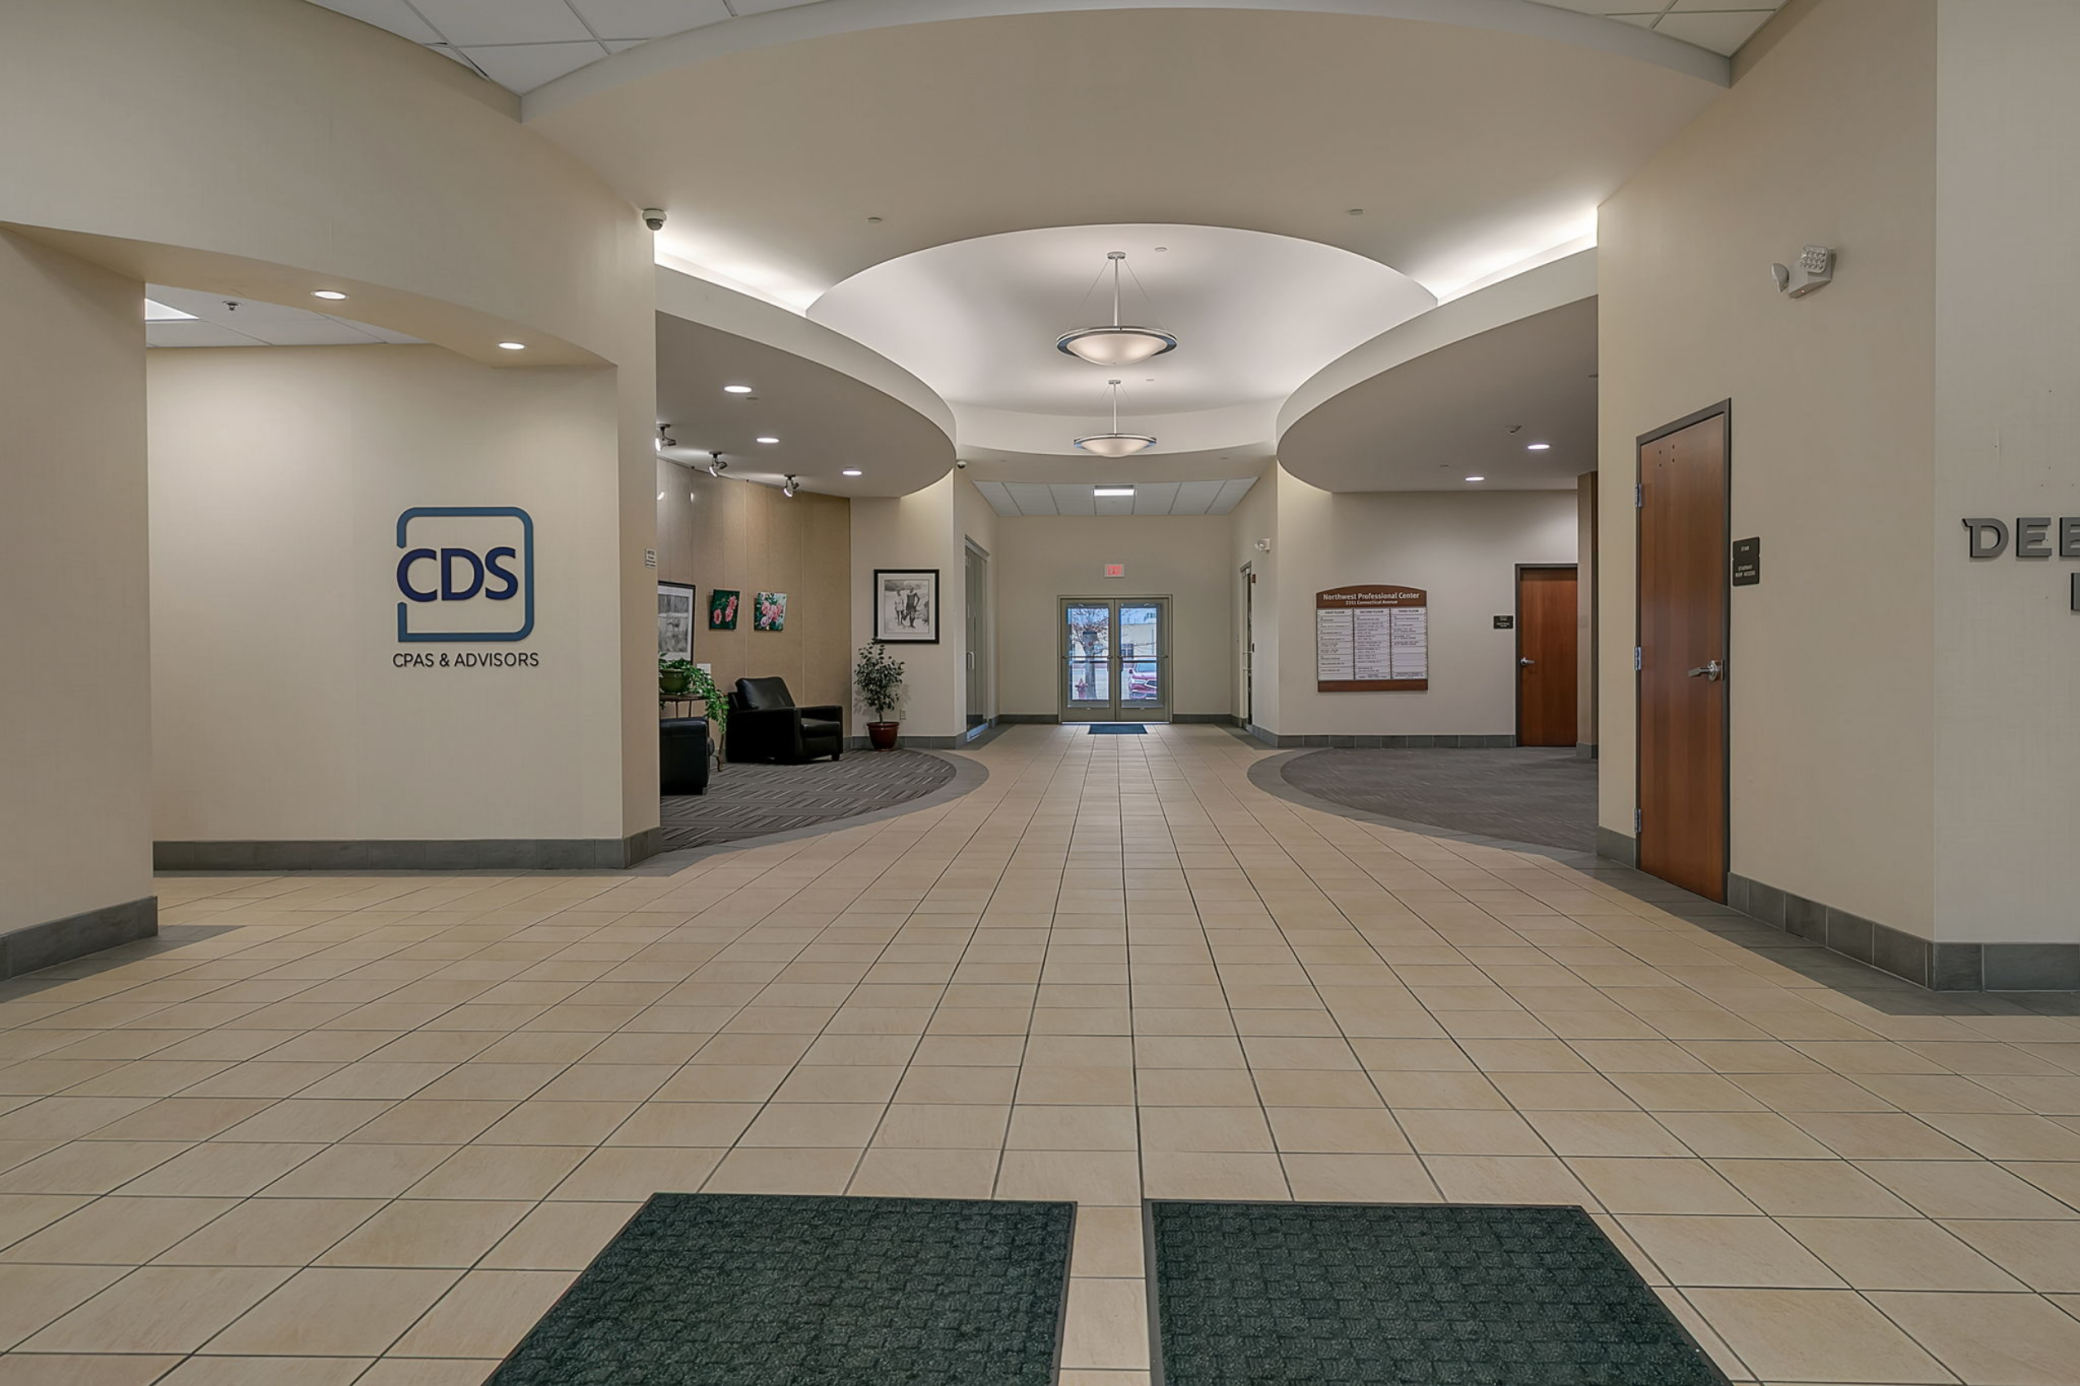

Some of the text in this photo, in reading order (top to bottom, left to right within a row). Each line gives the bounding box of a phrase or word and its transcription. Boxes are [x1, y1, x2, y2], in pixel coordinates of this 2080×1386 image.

[396, 546, 519, 603] CDS
[1358, 592, 1397, 600] Professional
[1398, 591, 1420, 599] Center
[392, 652, 540, 668] CPAS & ADVISORS
